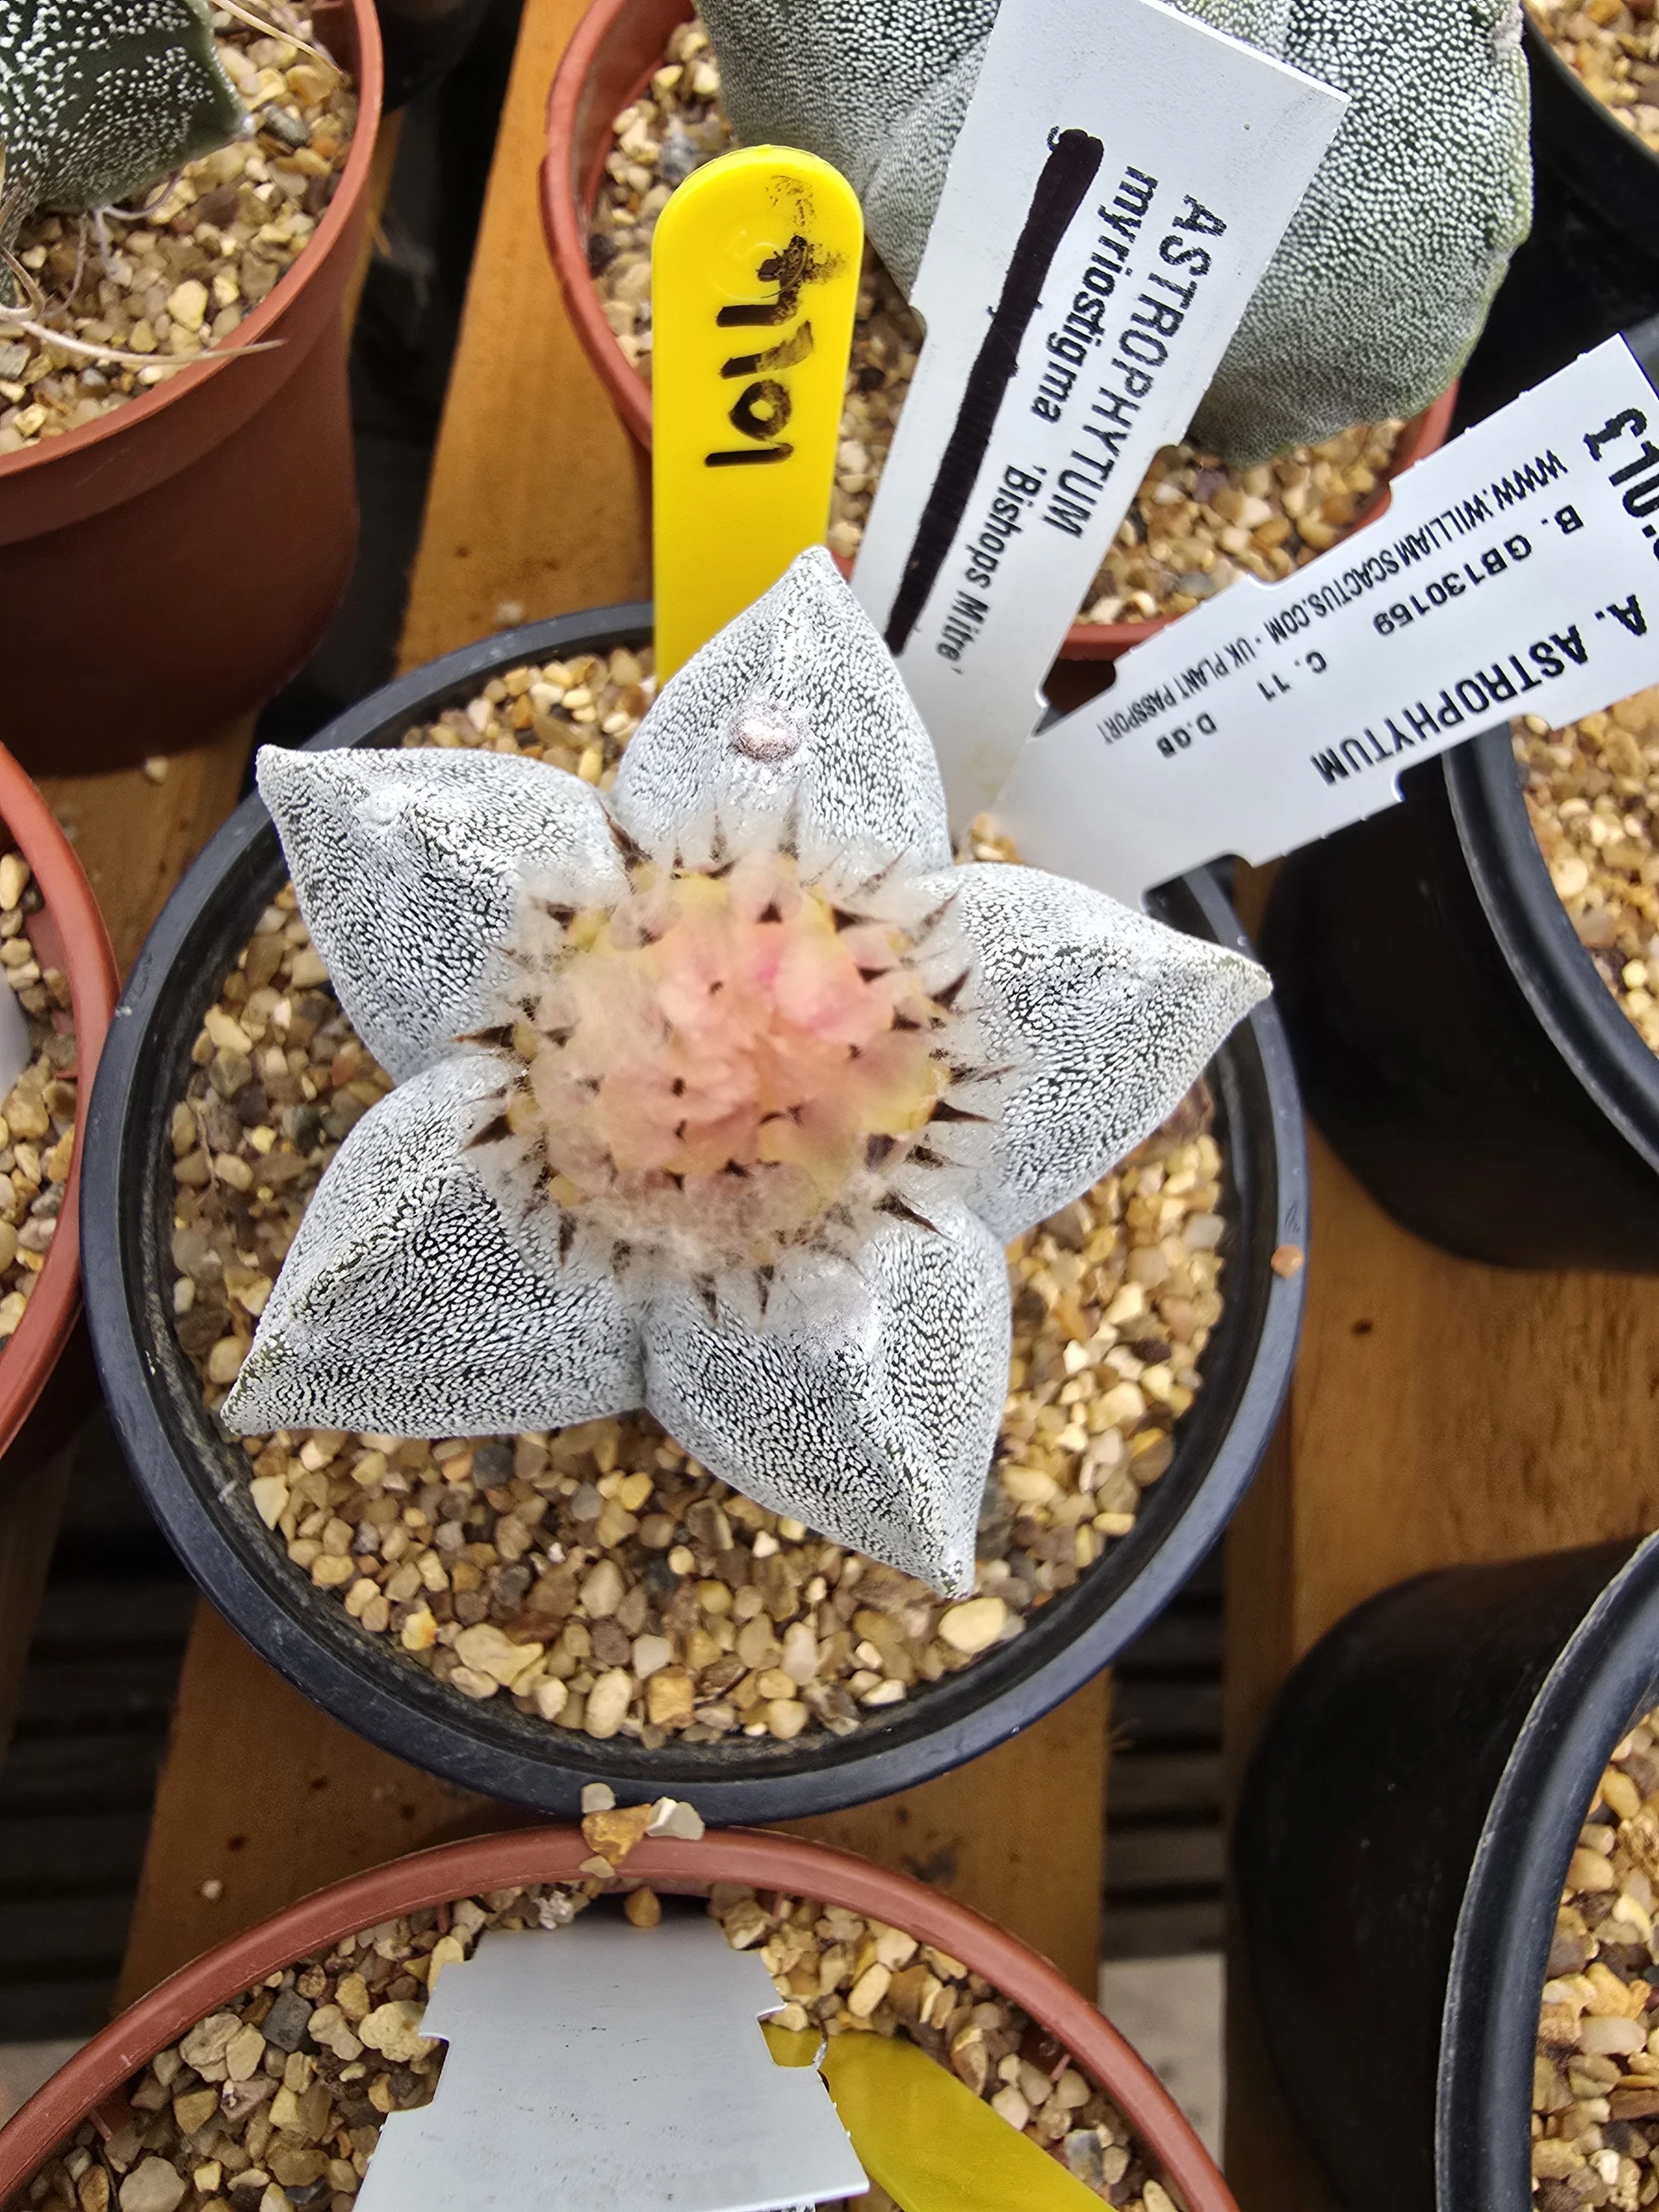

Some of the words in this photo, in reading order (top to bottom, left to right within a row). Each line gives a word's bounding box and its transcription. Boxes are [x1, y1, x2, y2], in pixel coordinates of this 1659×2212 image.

[1030, 165, 1160, 425] myriostigma
[1043, 194, 1228, 539] ASTROPHYTUM
[1582, 407, 1659, 561] £10.
[1541, 504, 1585, 535] B.
[1594, 594, 1648, 637] A.
[1172, 650, 1231, 701] PLANT
[1223, 636, 1257, 671] UK
[1293, 649, 1329, 676] C.
[1257, 674, 1291, 701] 11
[1309, 624, 1590, 785] ASTROPHYTUM
[1096, 684, 1178, 745] PASSPORT
